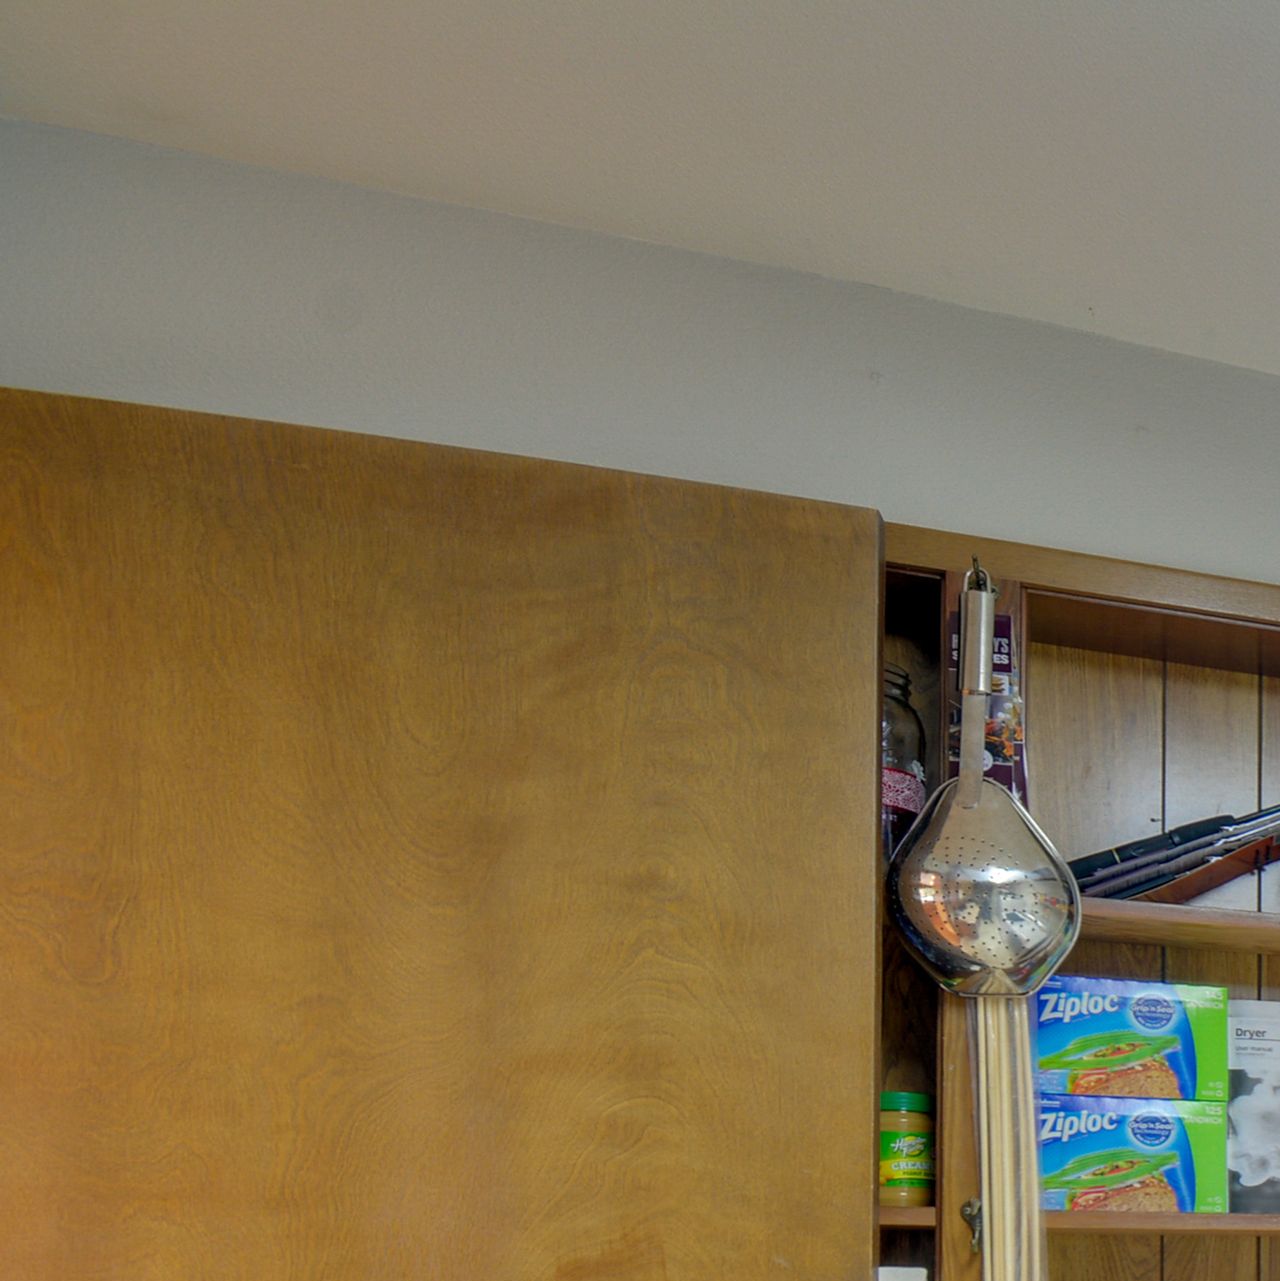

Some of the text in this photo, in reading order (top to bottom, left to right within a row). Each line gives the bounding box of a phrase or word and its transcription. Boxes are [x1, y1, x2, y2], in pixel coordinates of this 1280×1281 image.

[1039, 992, 1120, 1023] Ziploc
[1235, 1028, 1267, 1040] Dryer
[1040, 1110, 1118, 1142] Ziploc
